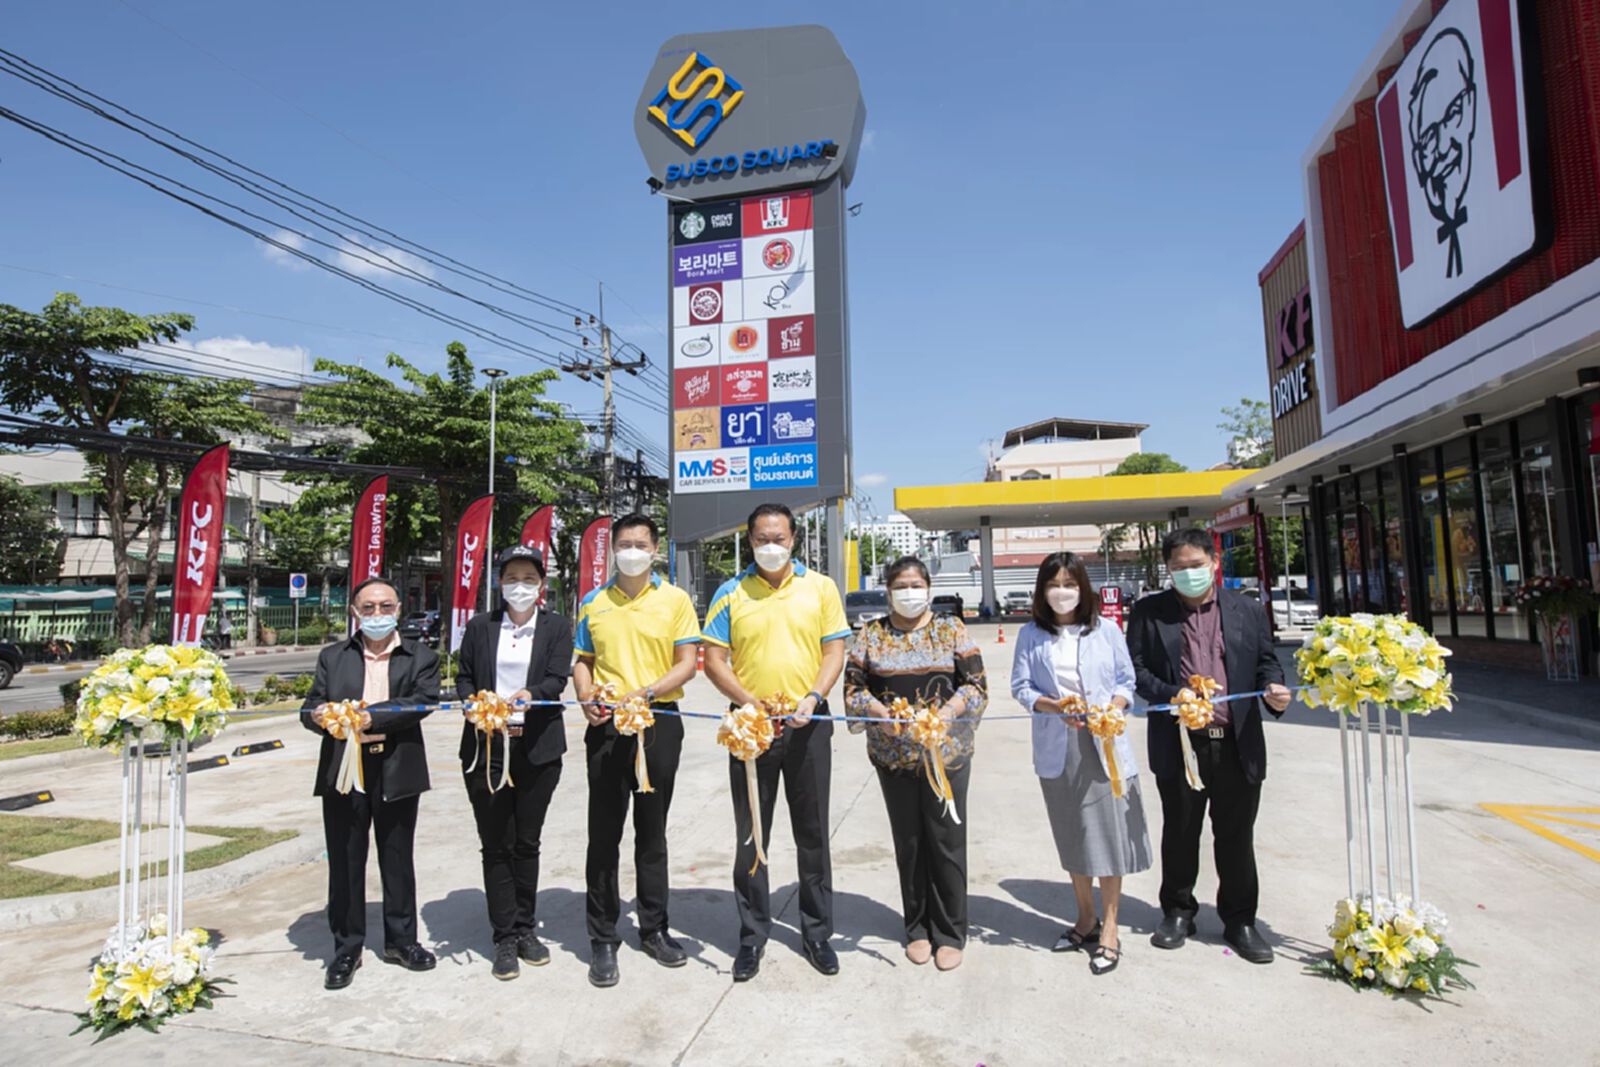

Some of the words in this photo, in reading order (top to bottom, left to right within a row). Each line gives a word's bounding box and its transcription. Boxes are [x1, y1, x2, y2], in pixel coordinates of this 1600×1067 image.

[666, 154, 739, 181] SUSCO
[743, 140, 835, 167] SQUAR
[766, 219, 785, 228] KFC
[678, 251, 738, 272] 보라마트
[707, 268, 724, 276] Mart
[1275, 284, 1310, 369] KF
[1273, 363, 1308, 419] DRIVE
[727, 411, 762, 438] ยา
[679, 457, 727, 478] MMS
[753, 452, 813, 470] ศูนย์บริการ
[694, 478, 725, 486] SERVICES
[186, 501, 212, 586] KFC
[367, 554, 380, 580] FC
[461, 532, 478, 589] KFC
